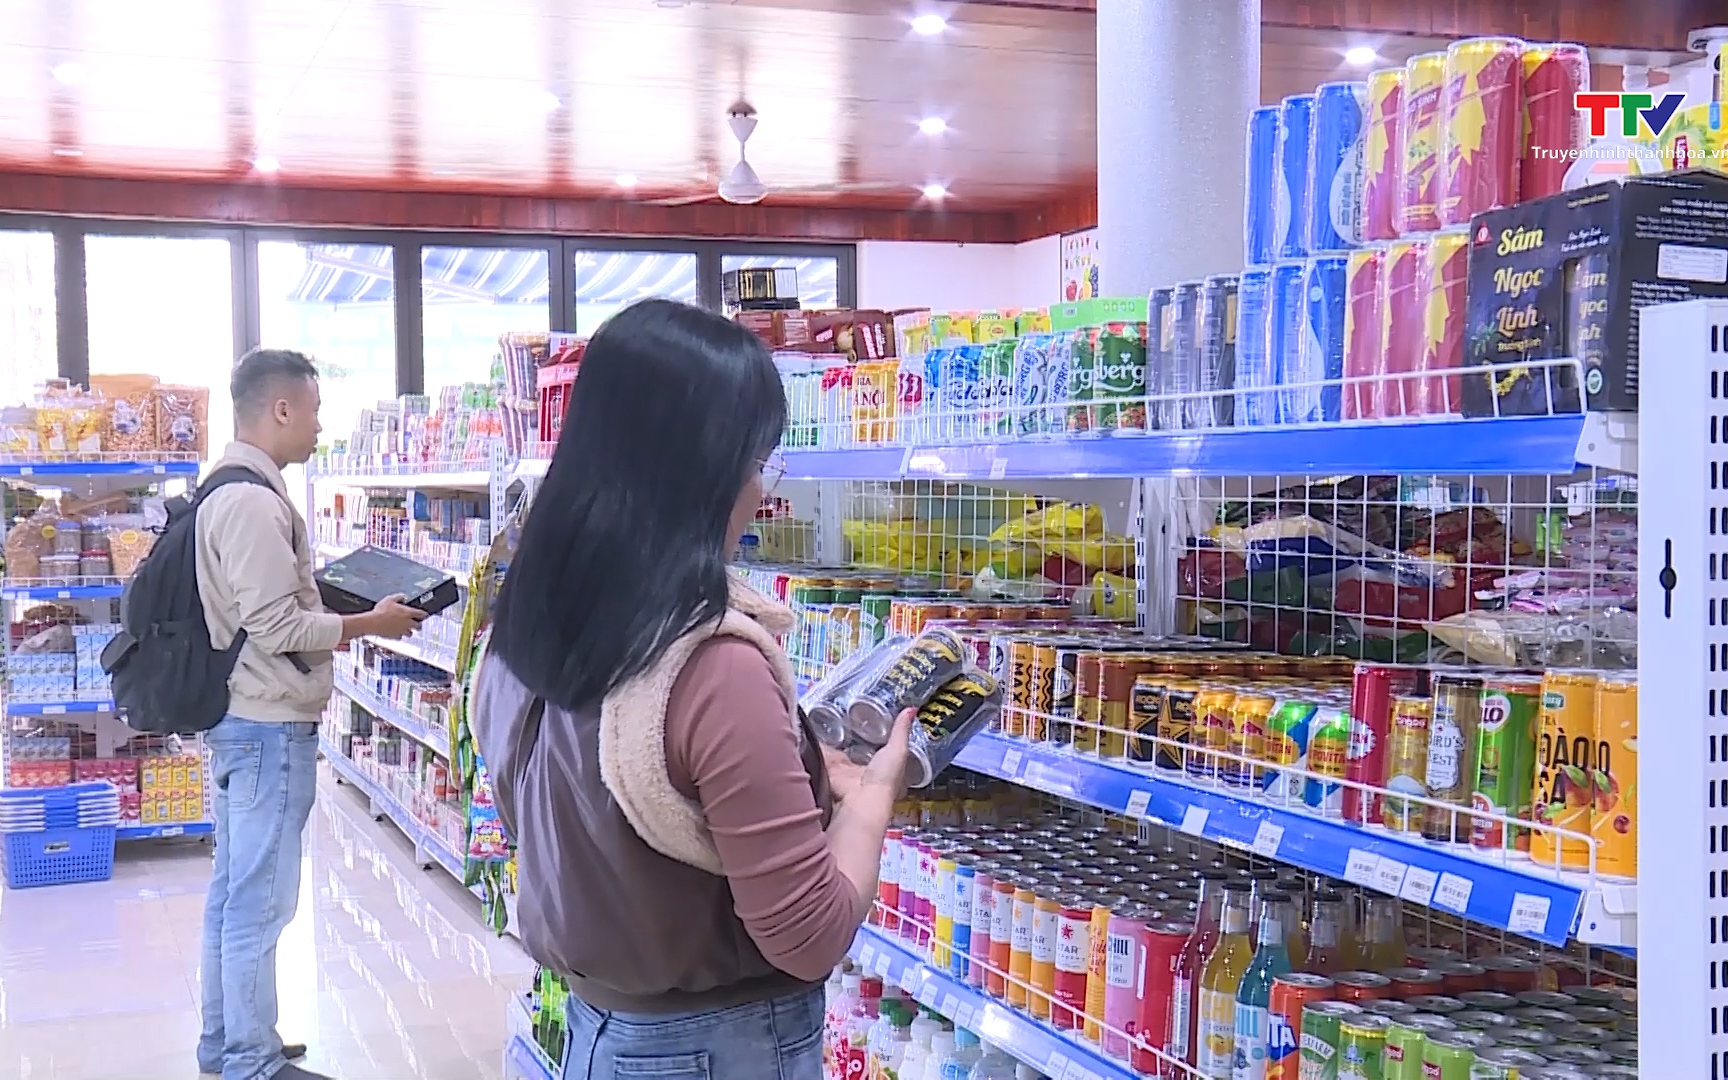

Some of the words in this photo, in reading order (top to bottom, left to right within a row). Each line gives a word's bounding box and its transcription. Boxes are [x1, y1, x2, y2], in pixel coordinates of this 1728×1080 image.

[1497, 227, 1544, 256] Sâm
[1494, 267, 1545, 298] Ngọc
[1496, 304, 1538, 337] Linh
